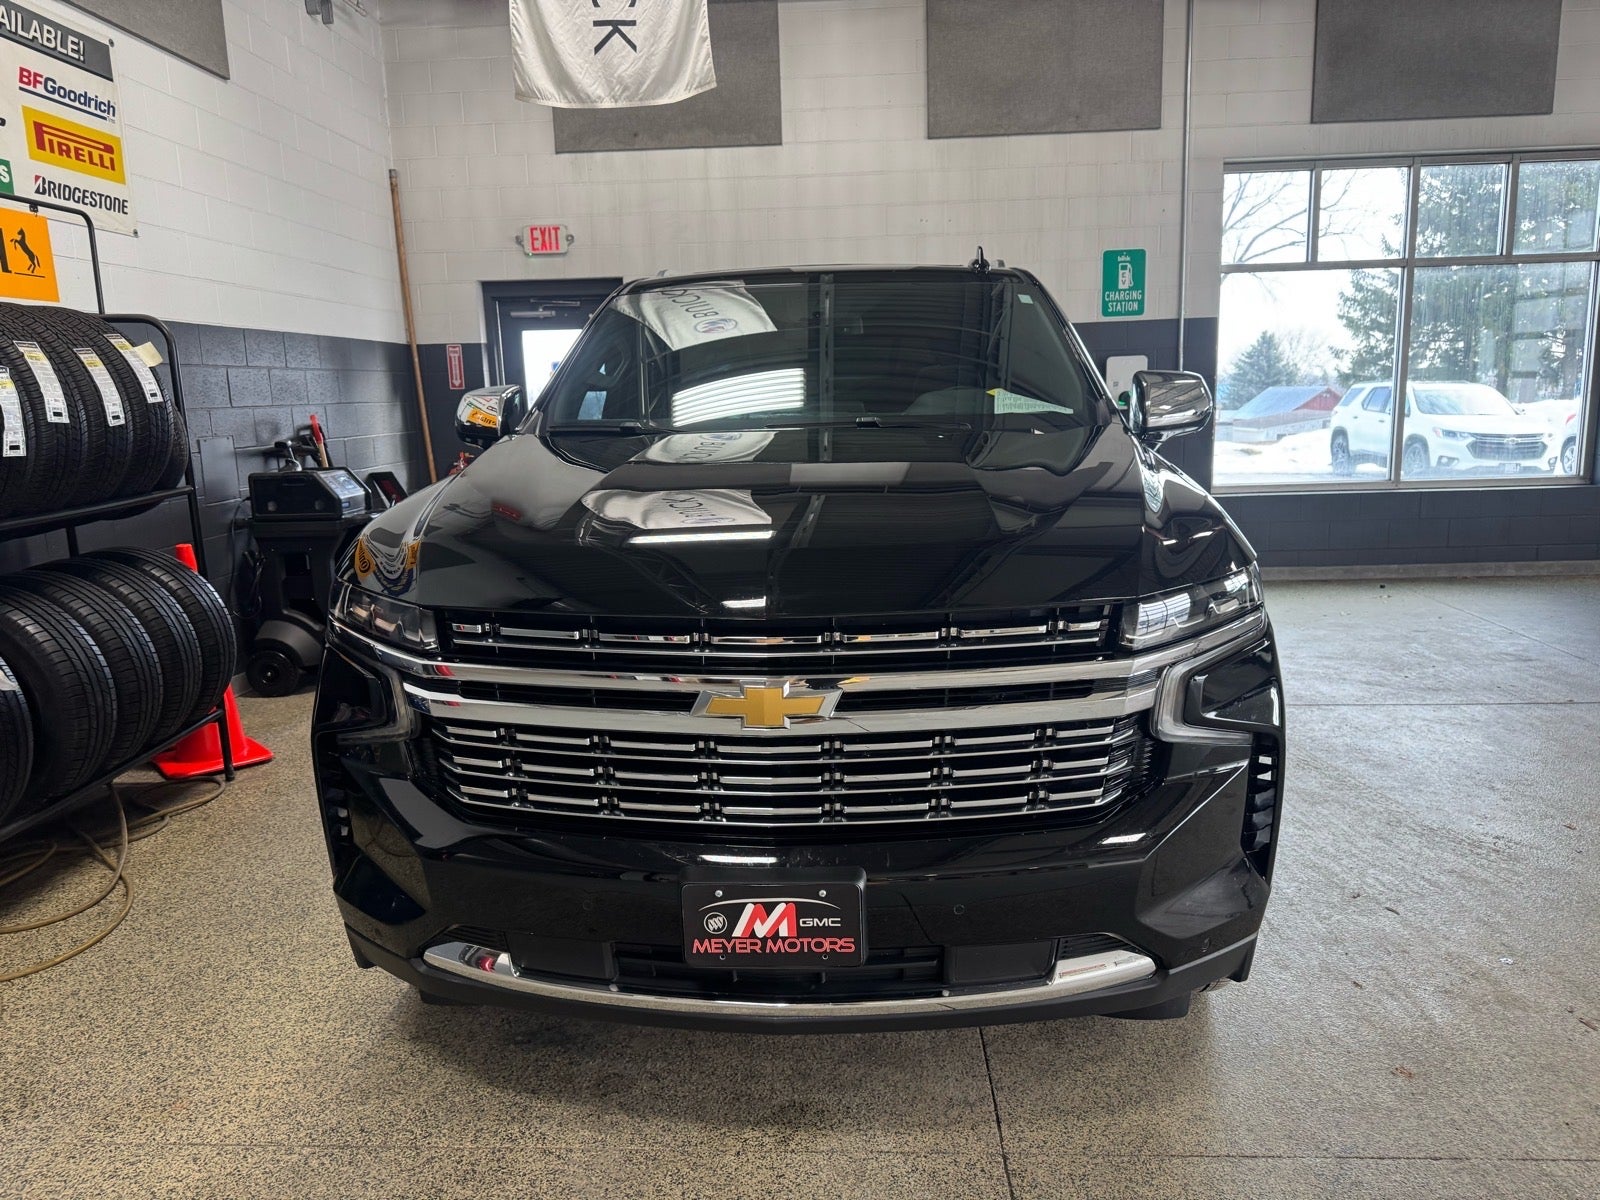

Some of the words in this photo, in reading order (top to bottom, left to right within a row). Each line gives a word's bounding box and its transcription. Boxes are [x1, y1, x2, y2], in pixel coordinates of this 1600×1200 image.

[592, 0, 637, 55] K
[19, 67, 116, 117] BFGoodrich
[33, 120, 115, 171] PIRELLI
[34, 175, 128, 215] BRIDGESTONE
[530, 227, 560, 252] EXIT
[1105, 290, 1142, 301] CHARGING
[1108, 301, 1139, 313] STATION
[799, 917, 841, 927] GMC
[693, 938, 762, 954] MEYER
[765, 938, 856, 953] MOTORS
